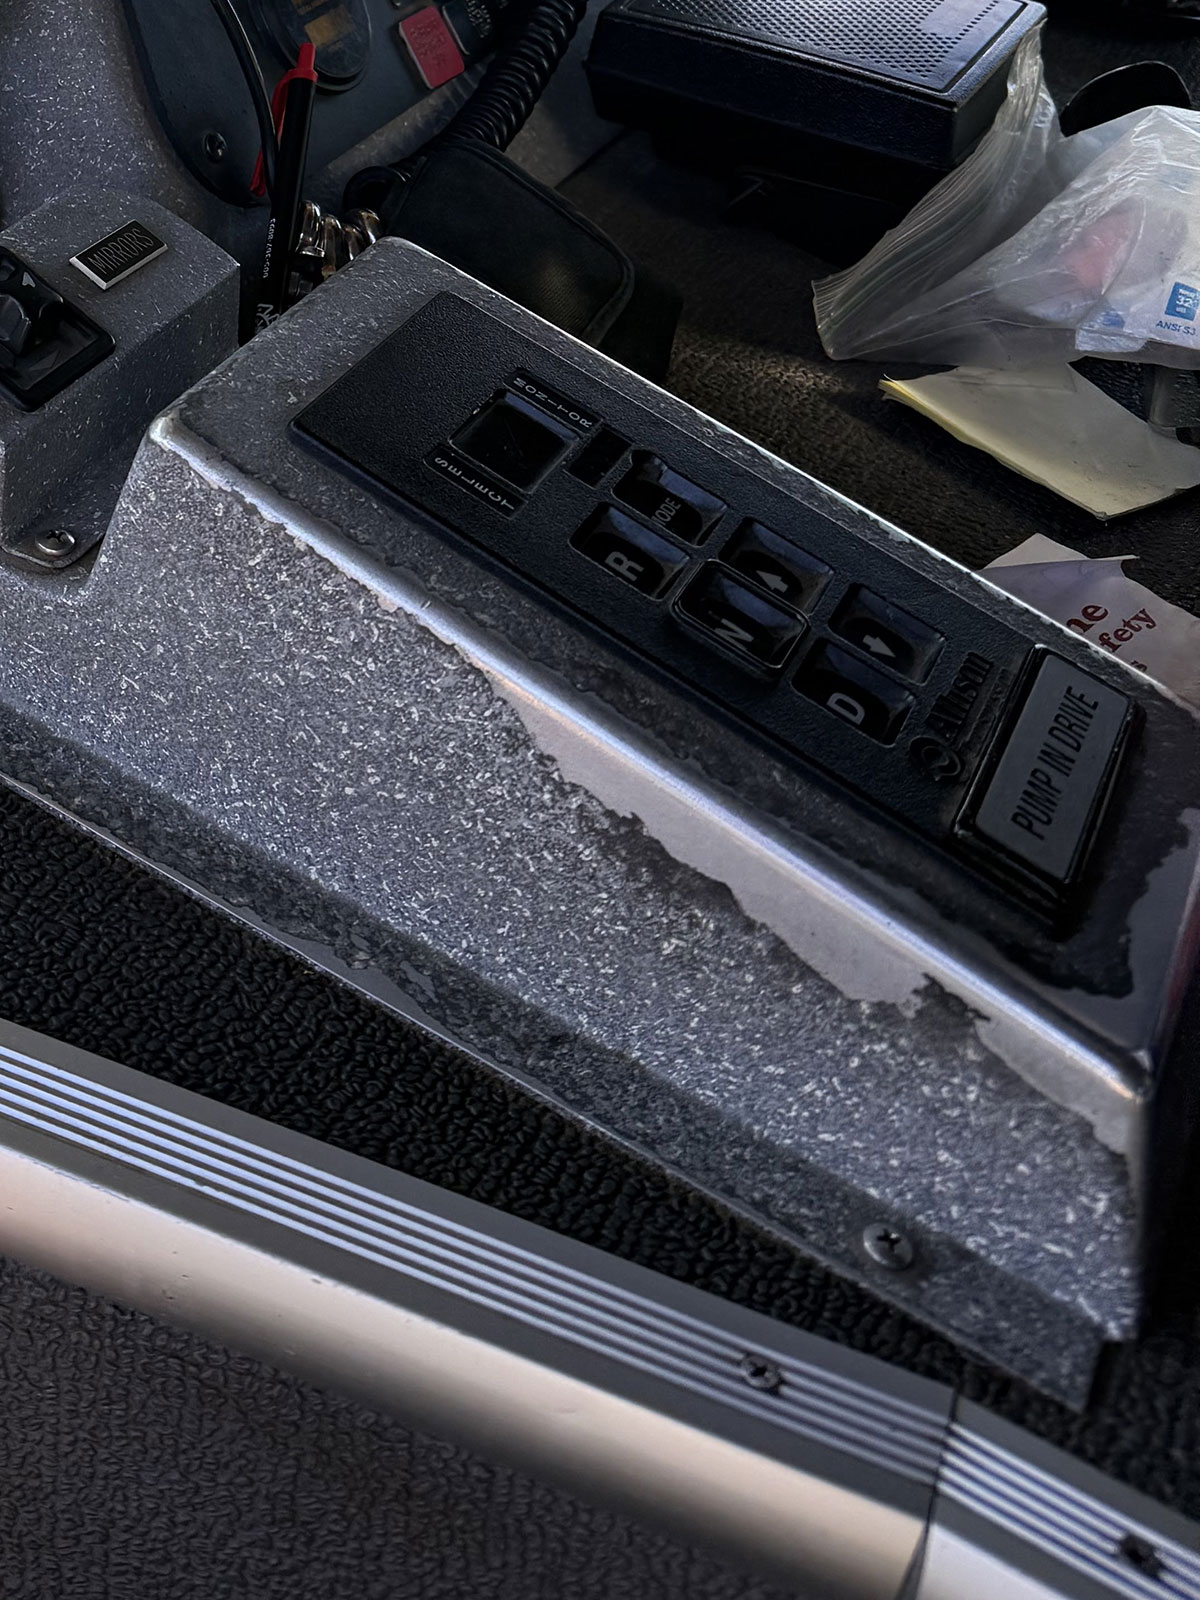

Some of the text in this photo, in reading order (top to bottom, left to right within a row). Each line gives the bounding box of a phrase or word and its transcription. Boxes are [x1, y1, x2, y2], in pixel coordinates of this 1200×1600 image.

[87, 228, 154, 275] MIRRORS
[1155, 320, 1181, 333] ANSI
[512, 376, 594, 429] MONITOR
[433, 455, 516, 511] SELECT
[604, 550, 645, 582] R
[713, 618, 755, 651] N
[825, 691, 867, 726] D
[925, 651, 995, 744] Allison
[1010, 685, 1100, 841] PUMP IN DRIVE
